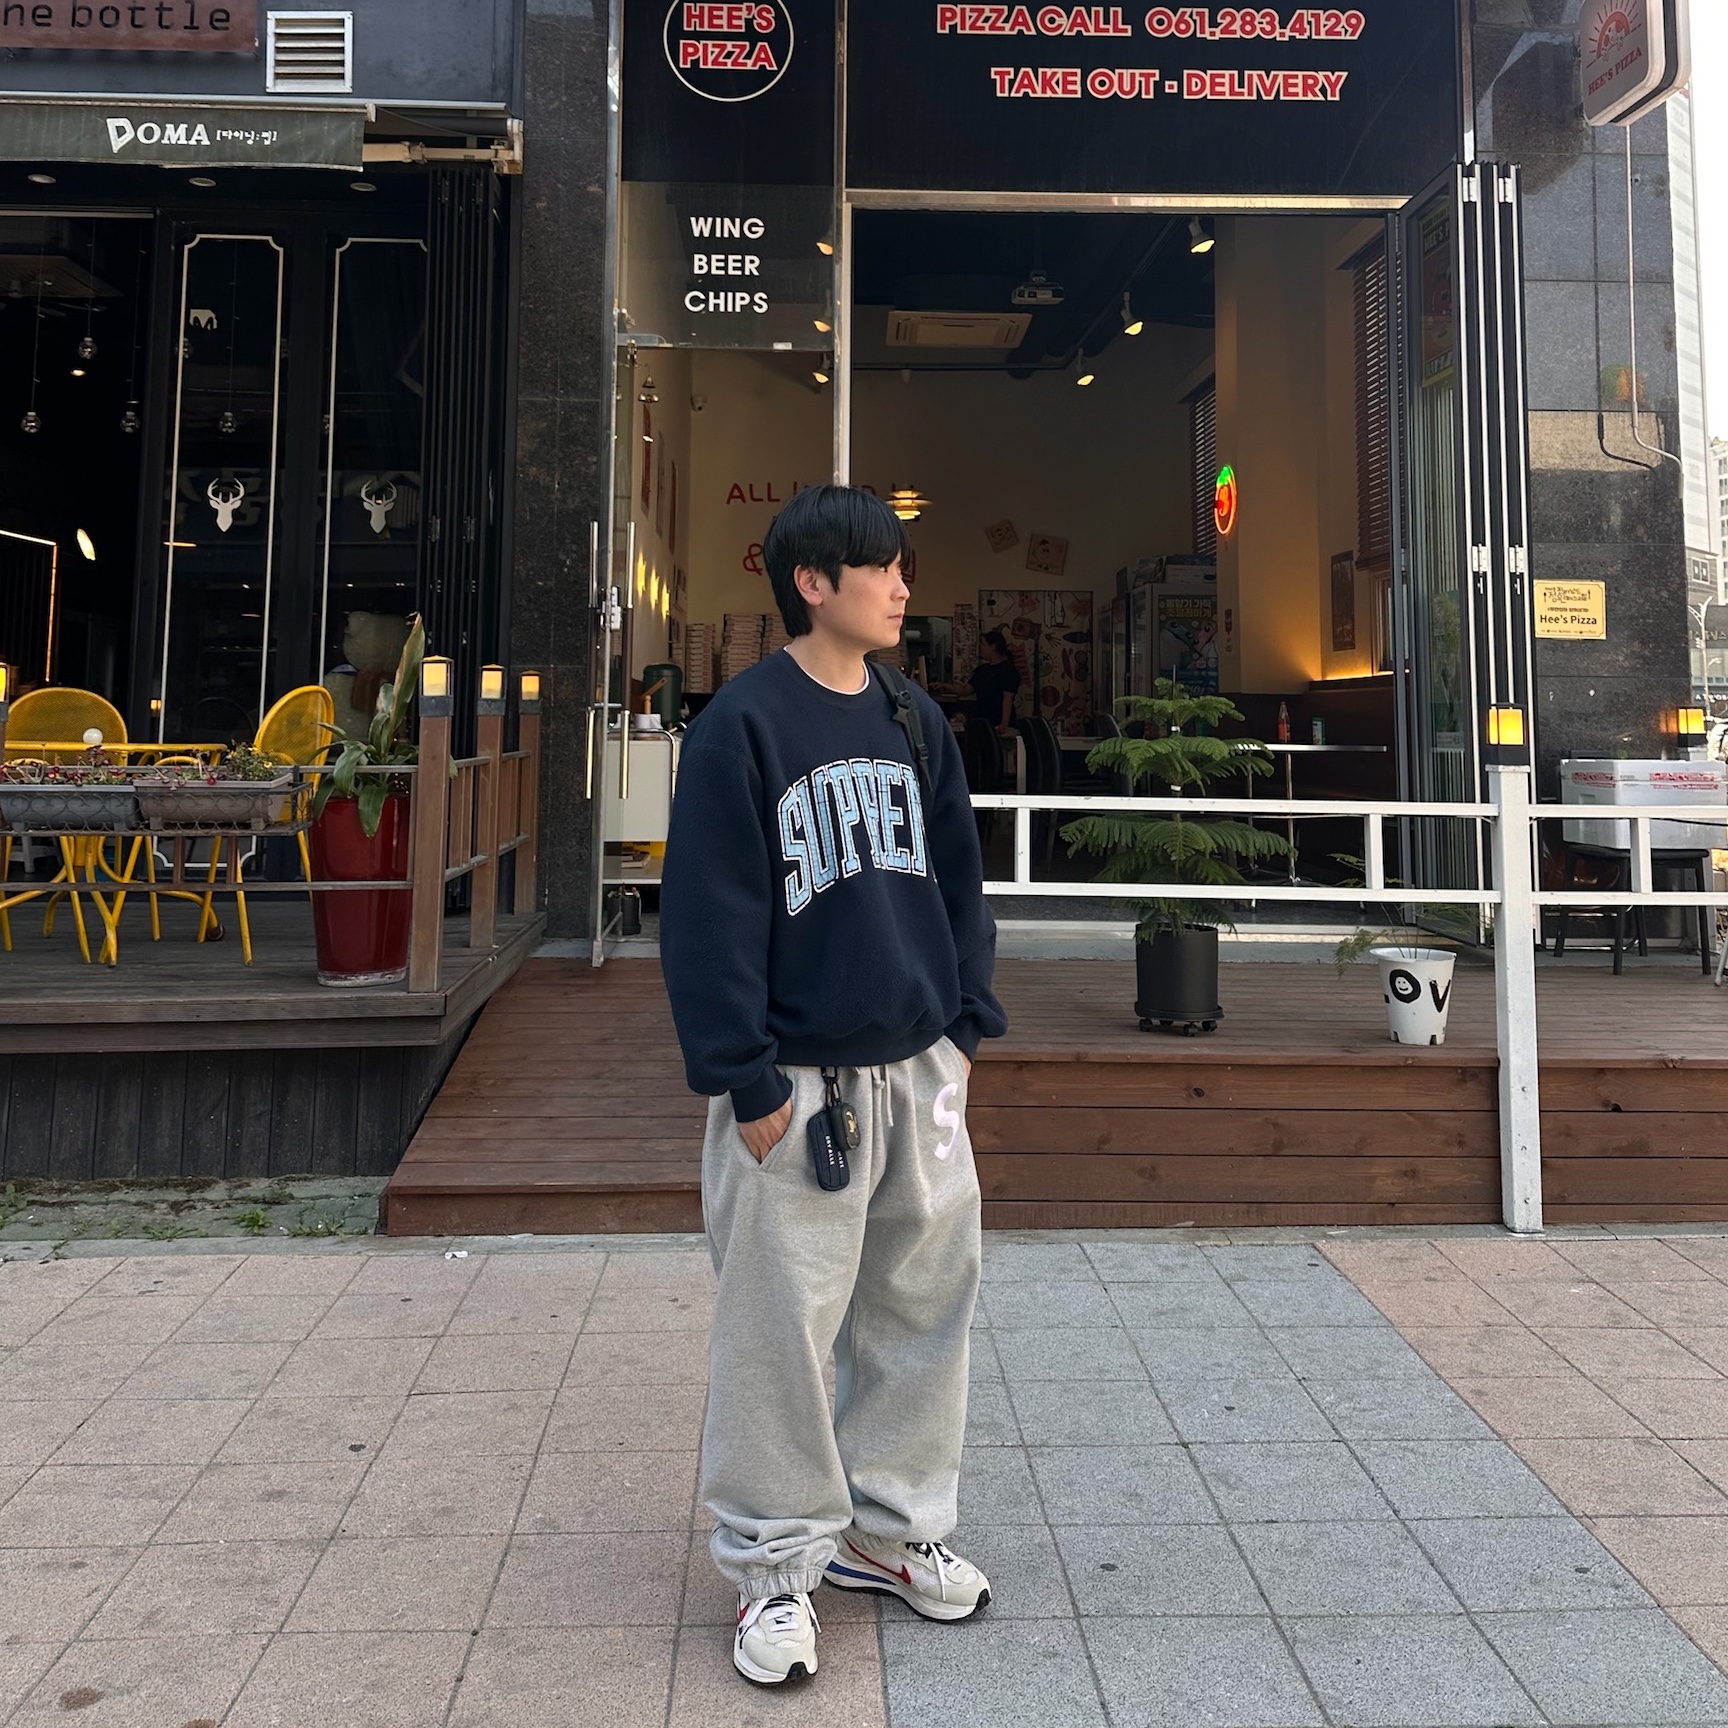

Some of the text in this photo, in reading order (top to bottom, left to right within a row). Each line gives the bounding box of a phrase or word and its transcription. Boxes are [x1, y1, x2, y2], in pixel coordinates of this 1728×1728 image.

[71, 0, 231, 31] bottle
[683, 2, 776, 34] HEE'S
[937, 3, 1366, 41] PIZZA CALL 061.283.4129
[679, 39, 779, 71] PIZZA
[990, 66, 1082, 98] TAKE
[1086, 68, 1160, 100] OUT
[1182, 69, 1349, 101] DELIVERY
[1587, 46, 1643, 96] HEE'S PIZZA
[105, 117, 211, 154] DOMA
[690, 216, 765, 239] WING
[693, 253, 760, 276] BEER
[684, 290, 769, 314] CHIPS
[726, 481, 781, 505] ALL
[1540, 614, 1597, 625] Hee's Pizza
